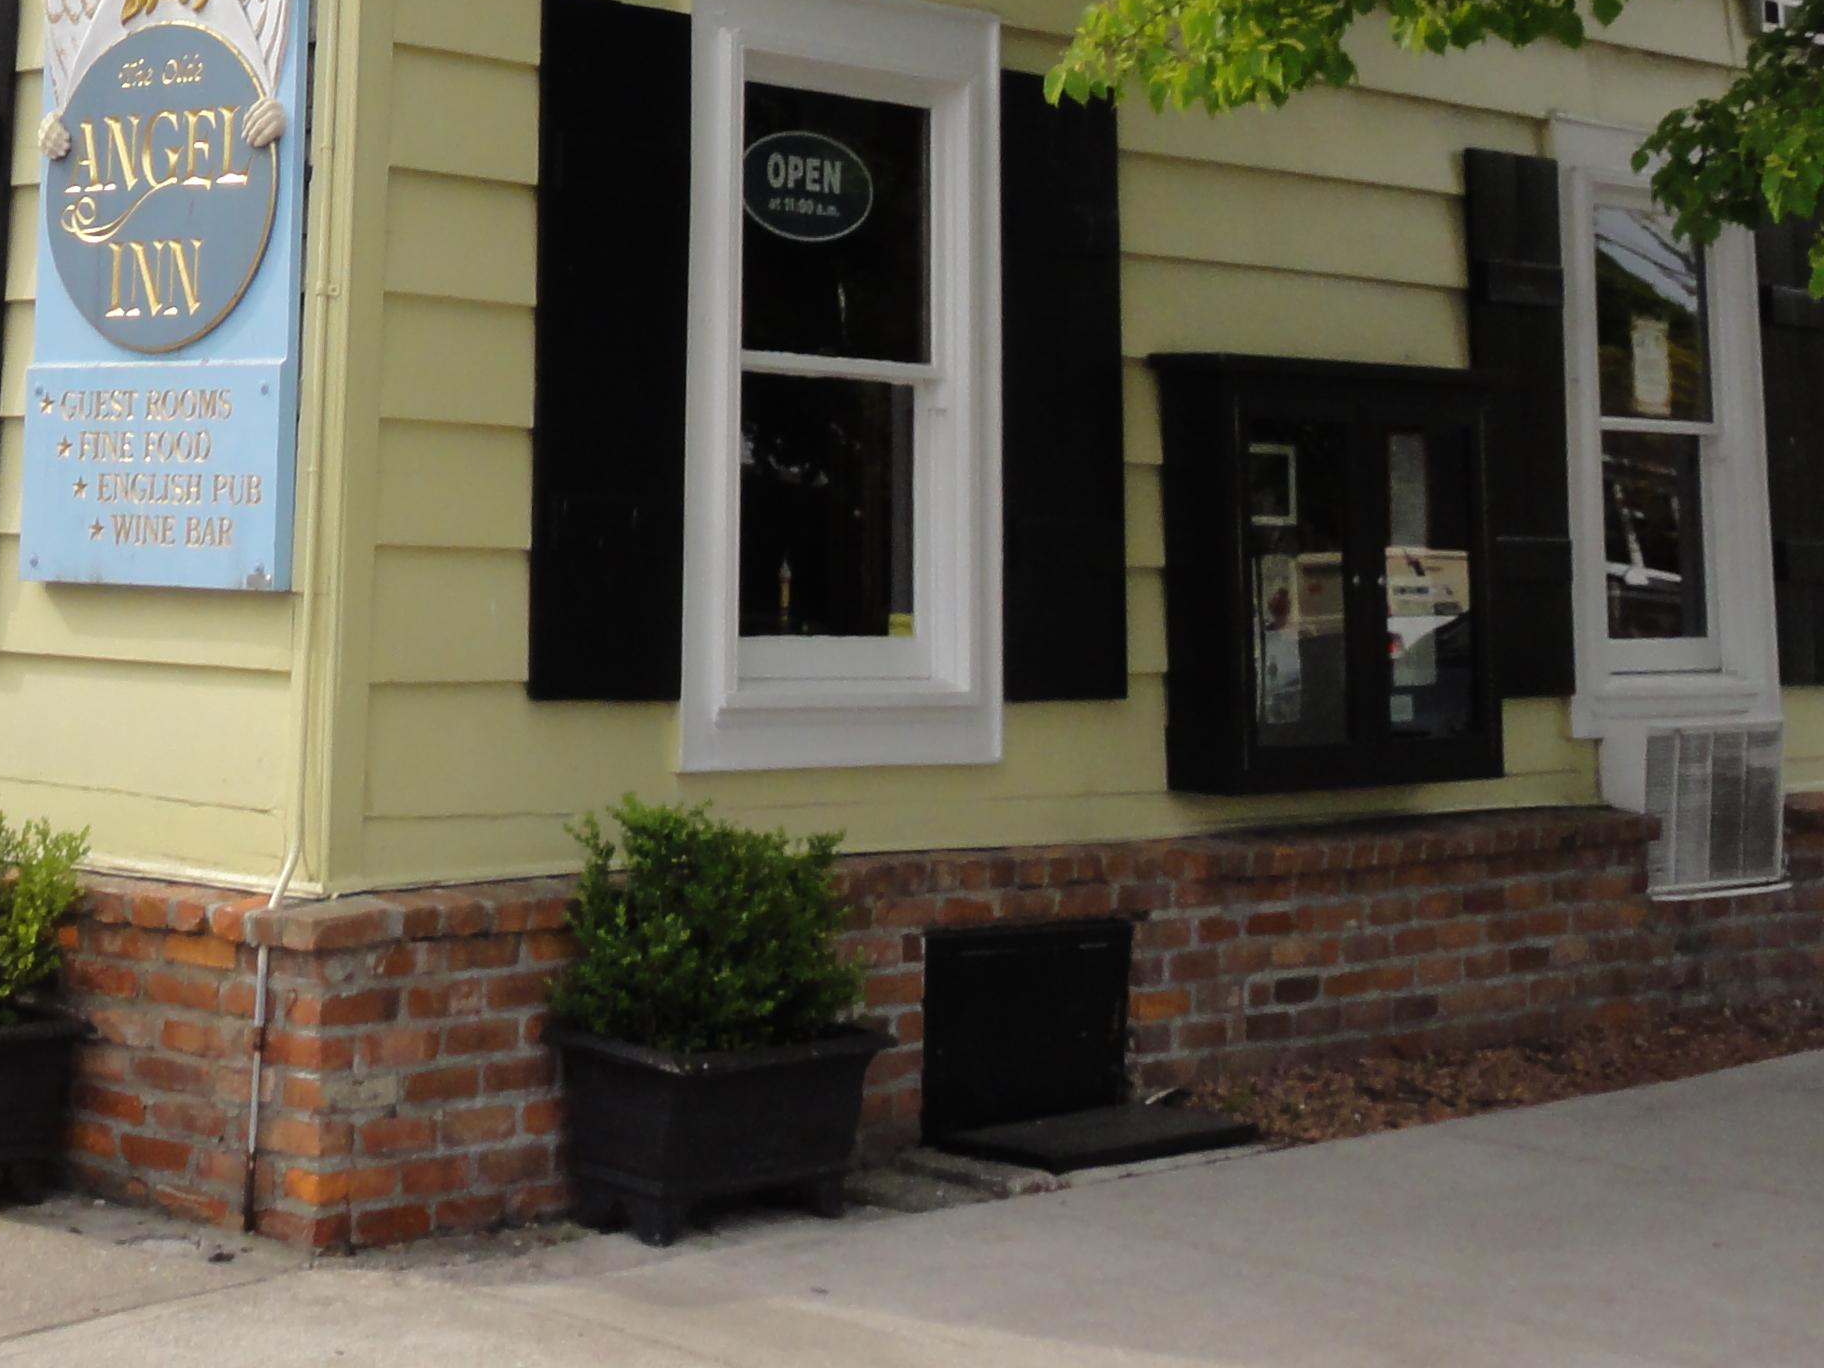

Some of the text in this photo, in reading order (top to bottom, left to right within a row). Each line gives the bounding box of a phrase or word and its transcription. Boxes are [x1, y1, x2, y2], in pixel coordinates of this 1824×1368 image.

[64, 105, 253, 194] ANGEL
[767, 152, 842, 195] OPEN
[105, 238, 203, 317] INN
[60, 389, 233, 421] GUEST ROOMS
[79, 430, 212, 463] FINE FOOD
[97, 472, 262, 506] ENGLISH PUB
[111, 513, 233, 548] WINE BAR
